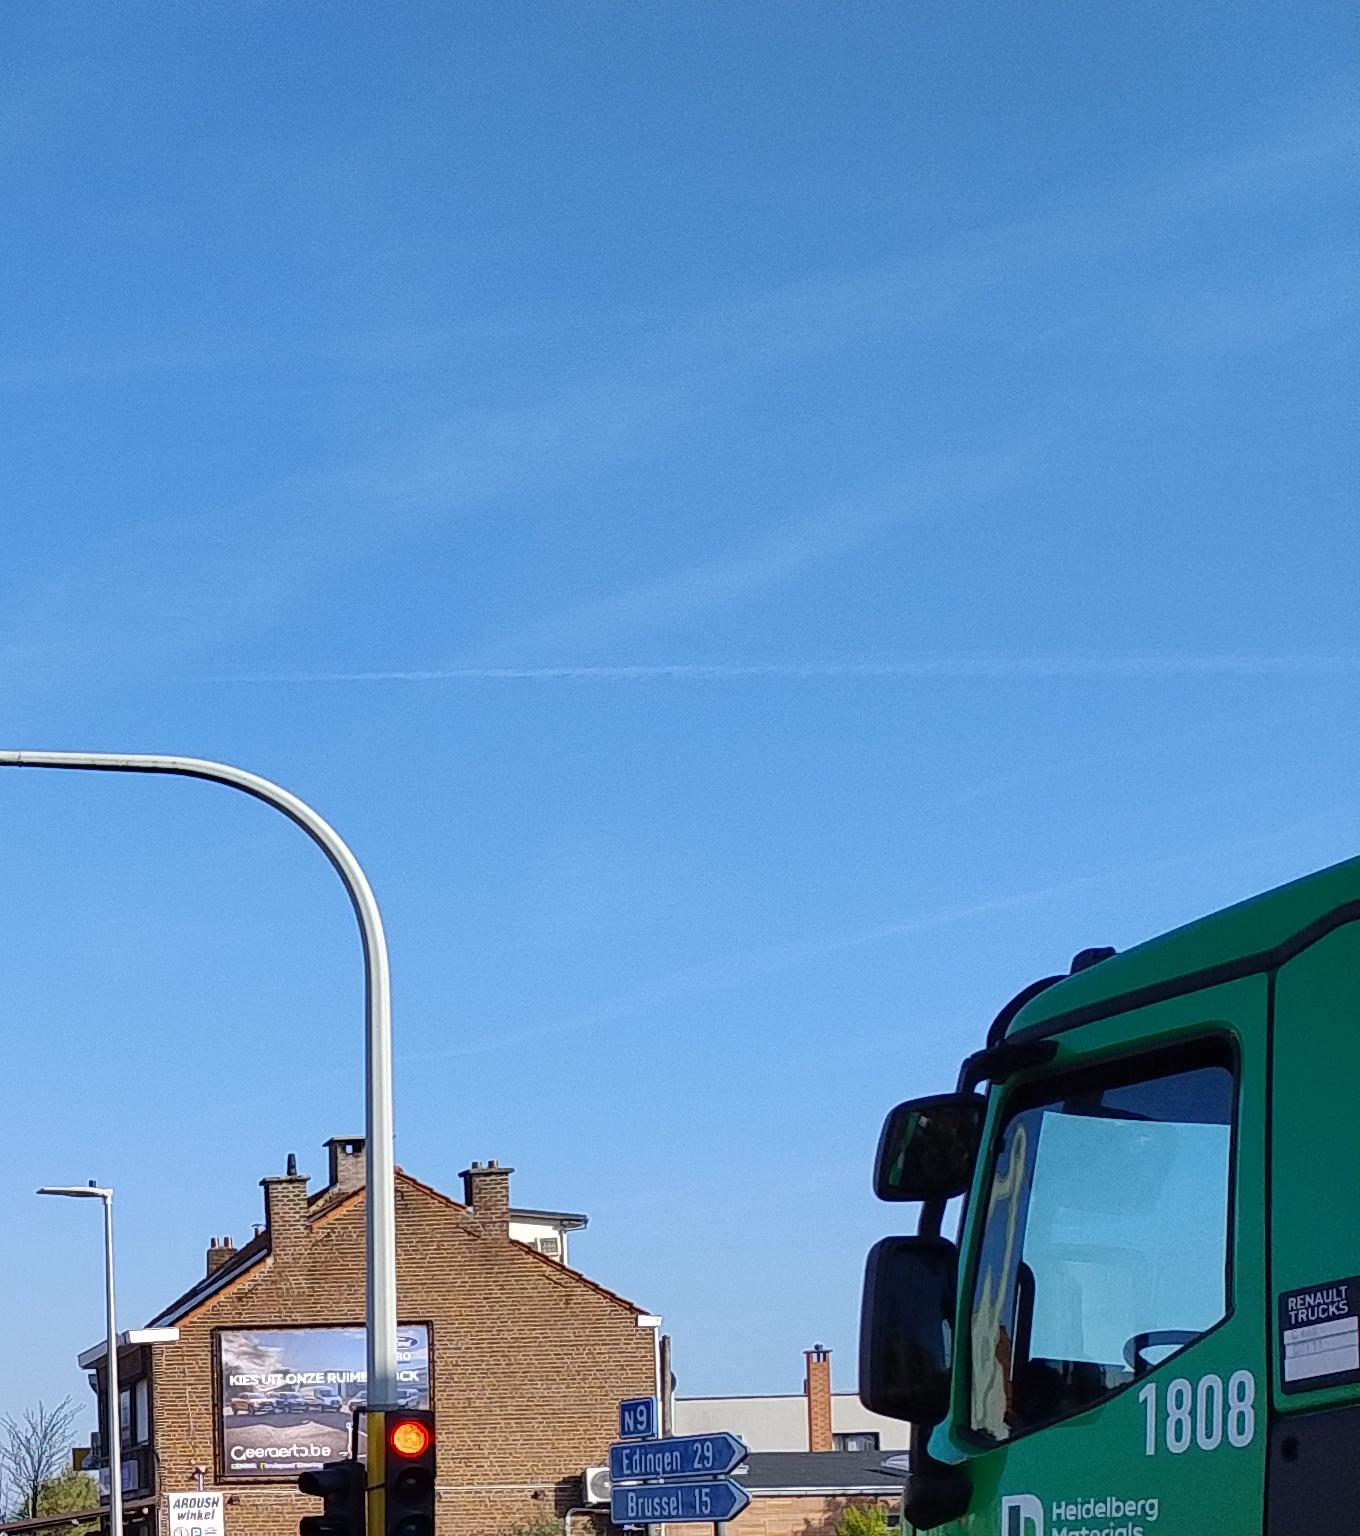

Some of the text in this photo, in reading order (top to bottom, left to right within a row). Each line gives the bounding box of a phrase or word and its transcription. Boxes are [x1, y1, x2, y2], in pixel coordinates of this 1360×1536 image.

[1288, 1286, 1348, 1311] RENAULT
[1288, 1300, 1349, 1324] TRUCKS
[230, 1375, 259, 1386] KIES
[261, 1374, 283, 1385] UIT
[286, 1373, 324, 1385] ONZE
[624, 1405, 647, 1432] N9
[1138, 1369, 1255, 1456] 1808
[622, 1441, 713, 1475] Edingen 29
[173, 1496, 220, 1509] AROUSH
[627, 1488, 711, 1517] Brussel 15
[1052, 1497, 1158, 1521] Heidelberg
[177, 1509, 216, 1521] winkel
